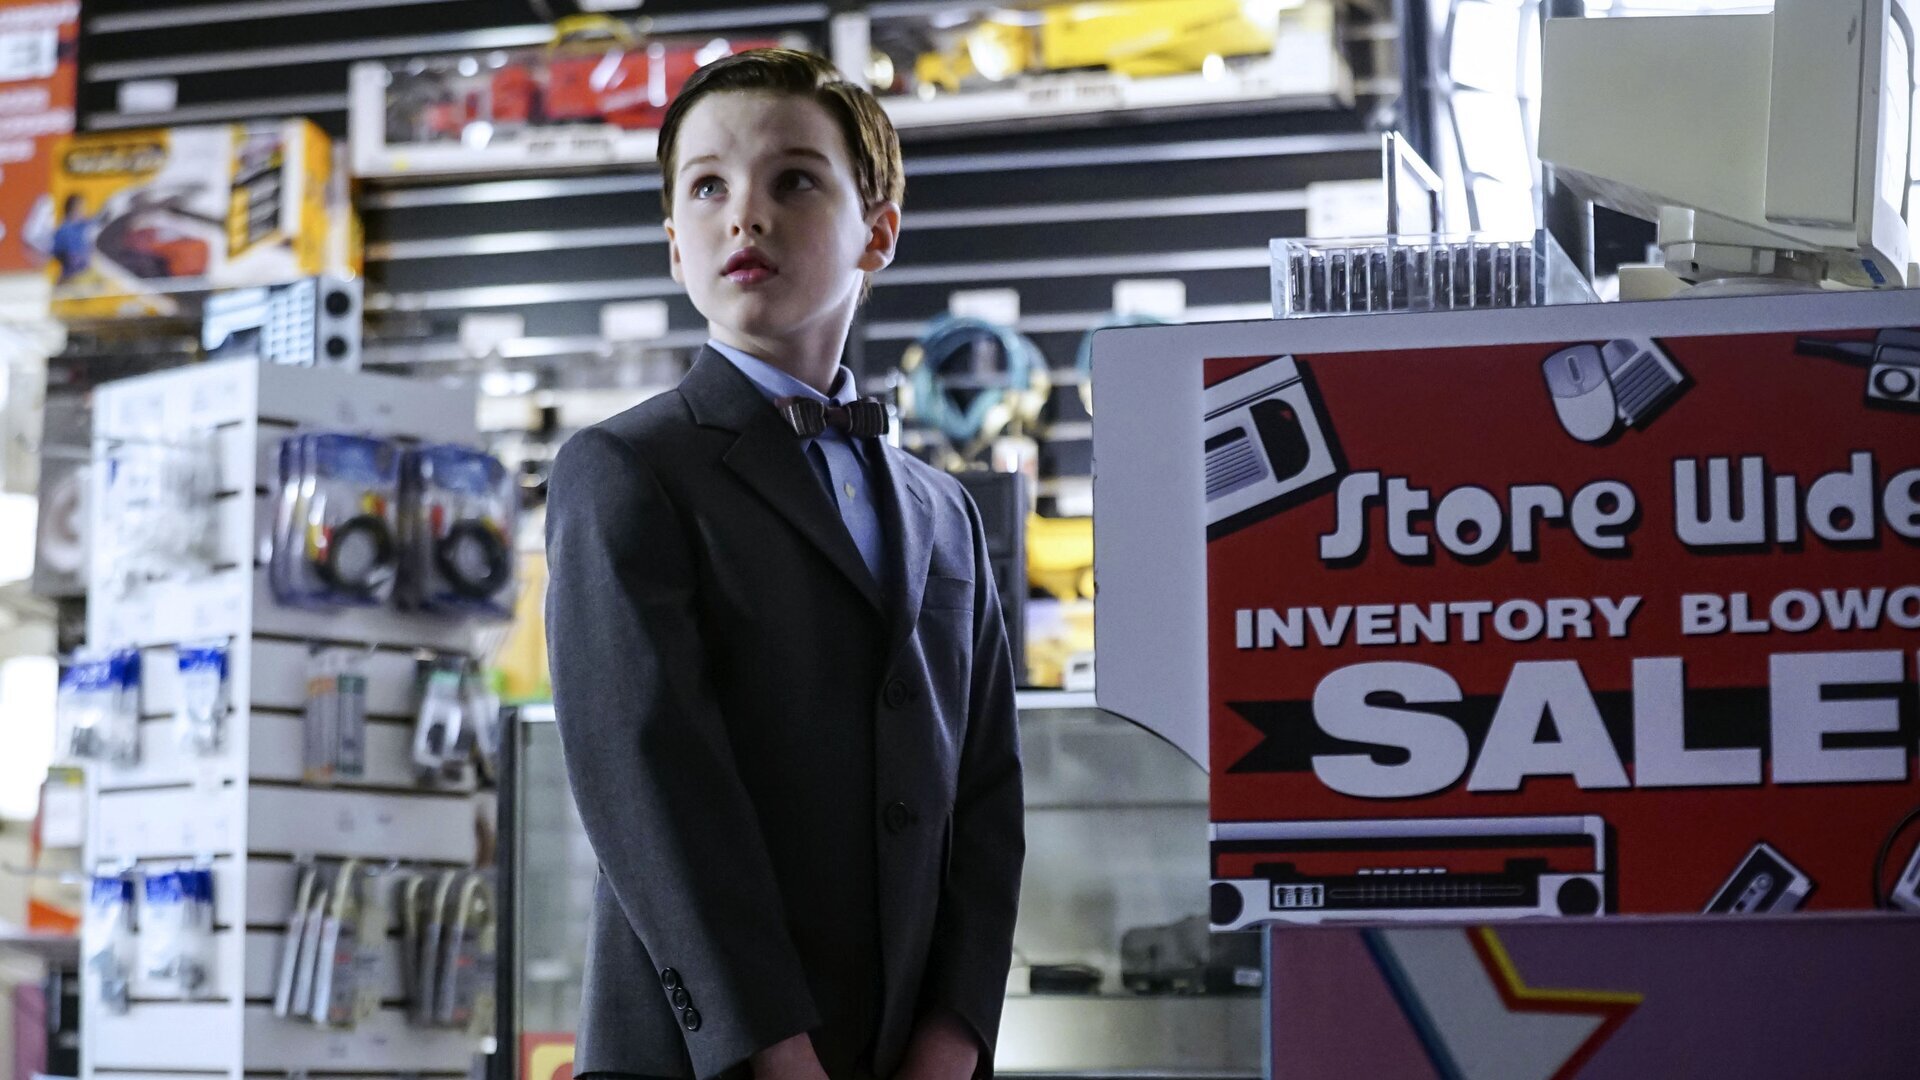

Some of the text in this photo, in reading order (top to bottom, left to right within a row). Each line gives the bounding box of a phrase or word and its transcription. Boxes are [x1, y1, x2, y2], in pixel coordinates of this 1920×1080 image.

[1319, 470, 1637, 560] Store
[1235, 595, 1642, 649] INVENTORY
[1311, 649, 1920, 798] SALE
